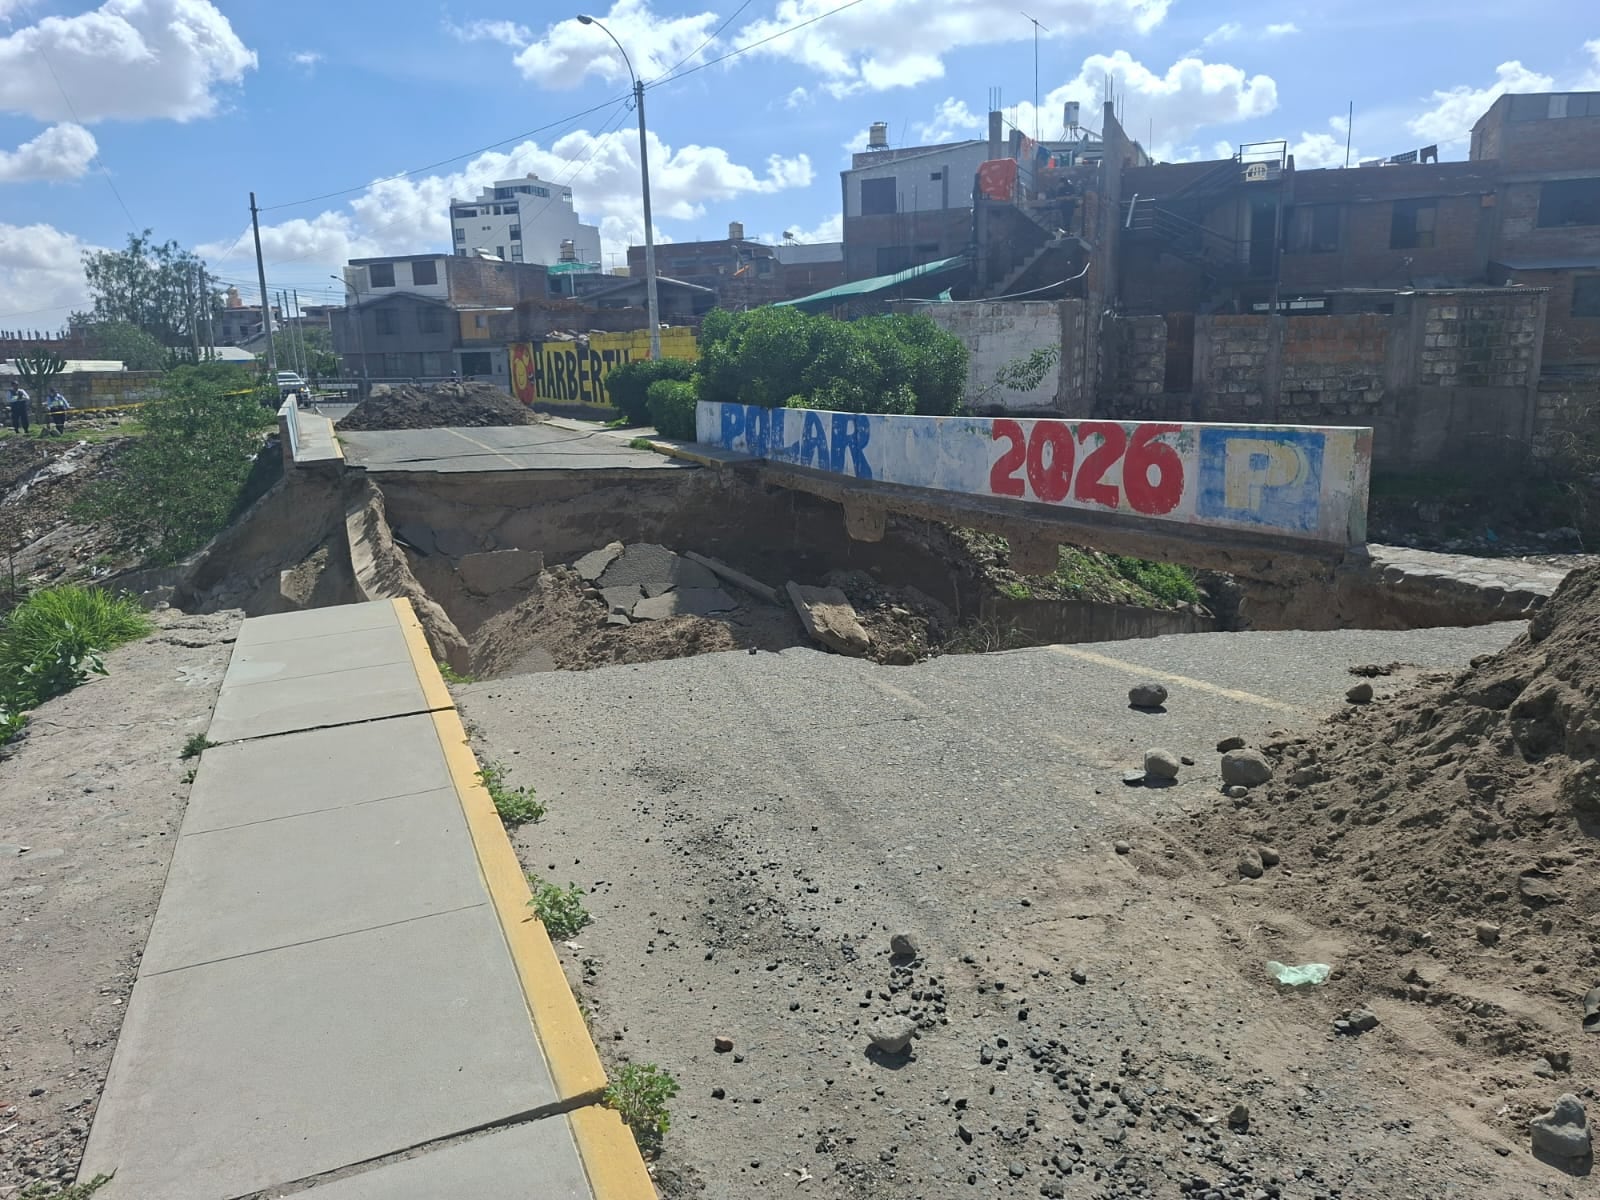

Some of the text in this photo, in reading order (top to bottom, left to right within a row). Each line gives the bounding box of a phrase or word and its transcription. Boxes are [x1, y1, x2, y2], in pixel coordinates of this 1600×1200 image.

[533, 348, 630, 403] HARBERT
[721, 403, 873, 480] POLAR
[991, 419, 1184, 516] 2026
